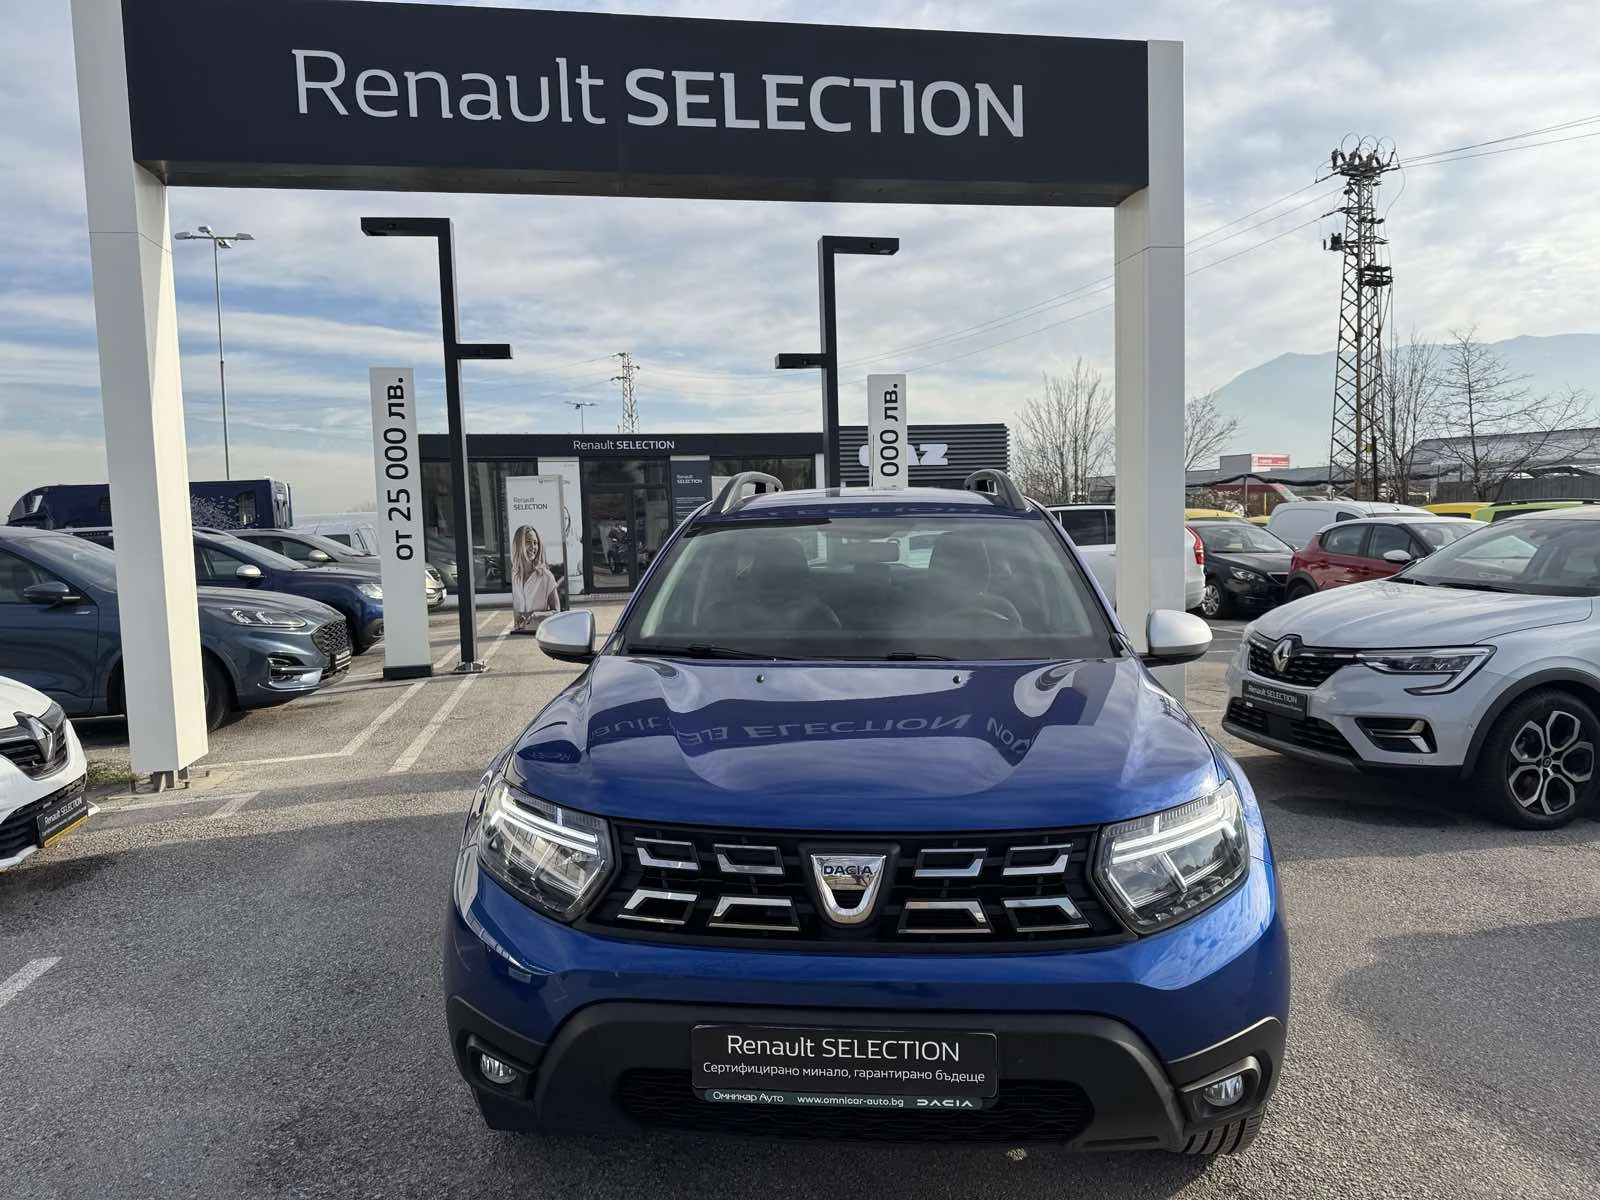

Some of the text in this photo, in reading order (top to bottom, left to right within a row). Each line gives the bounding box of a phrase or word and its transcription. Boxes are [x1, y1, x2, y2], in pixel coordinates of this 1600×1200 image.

[291, 49, 1024, 138] Renault SELECTION
[879, 383, 899, 477] 000 лв.
[573, 440, 675, 450] Renault SELECTION
[383, 377, 414, 561] от 25 000 лв.
[512, 503, 548, 511] SELECTION
[823, 865, 873, 875] DACIA
[727, 1034, 959, 1062] Renault SELECTION
[703, 1062, 986, 1083] Сертифицирано минало, гарантирано бъдеще
[712, 1091, 785, 1104] Омникар Ауто
[797, 1095, 904, 1108] www.omnicar-auto.bg
[916, 1099, 973, 1108] DACIA
